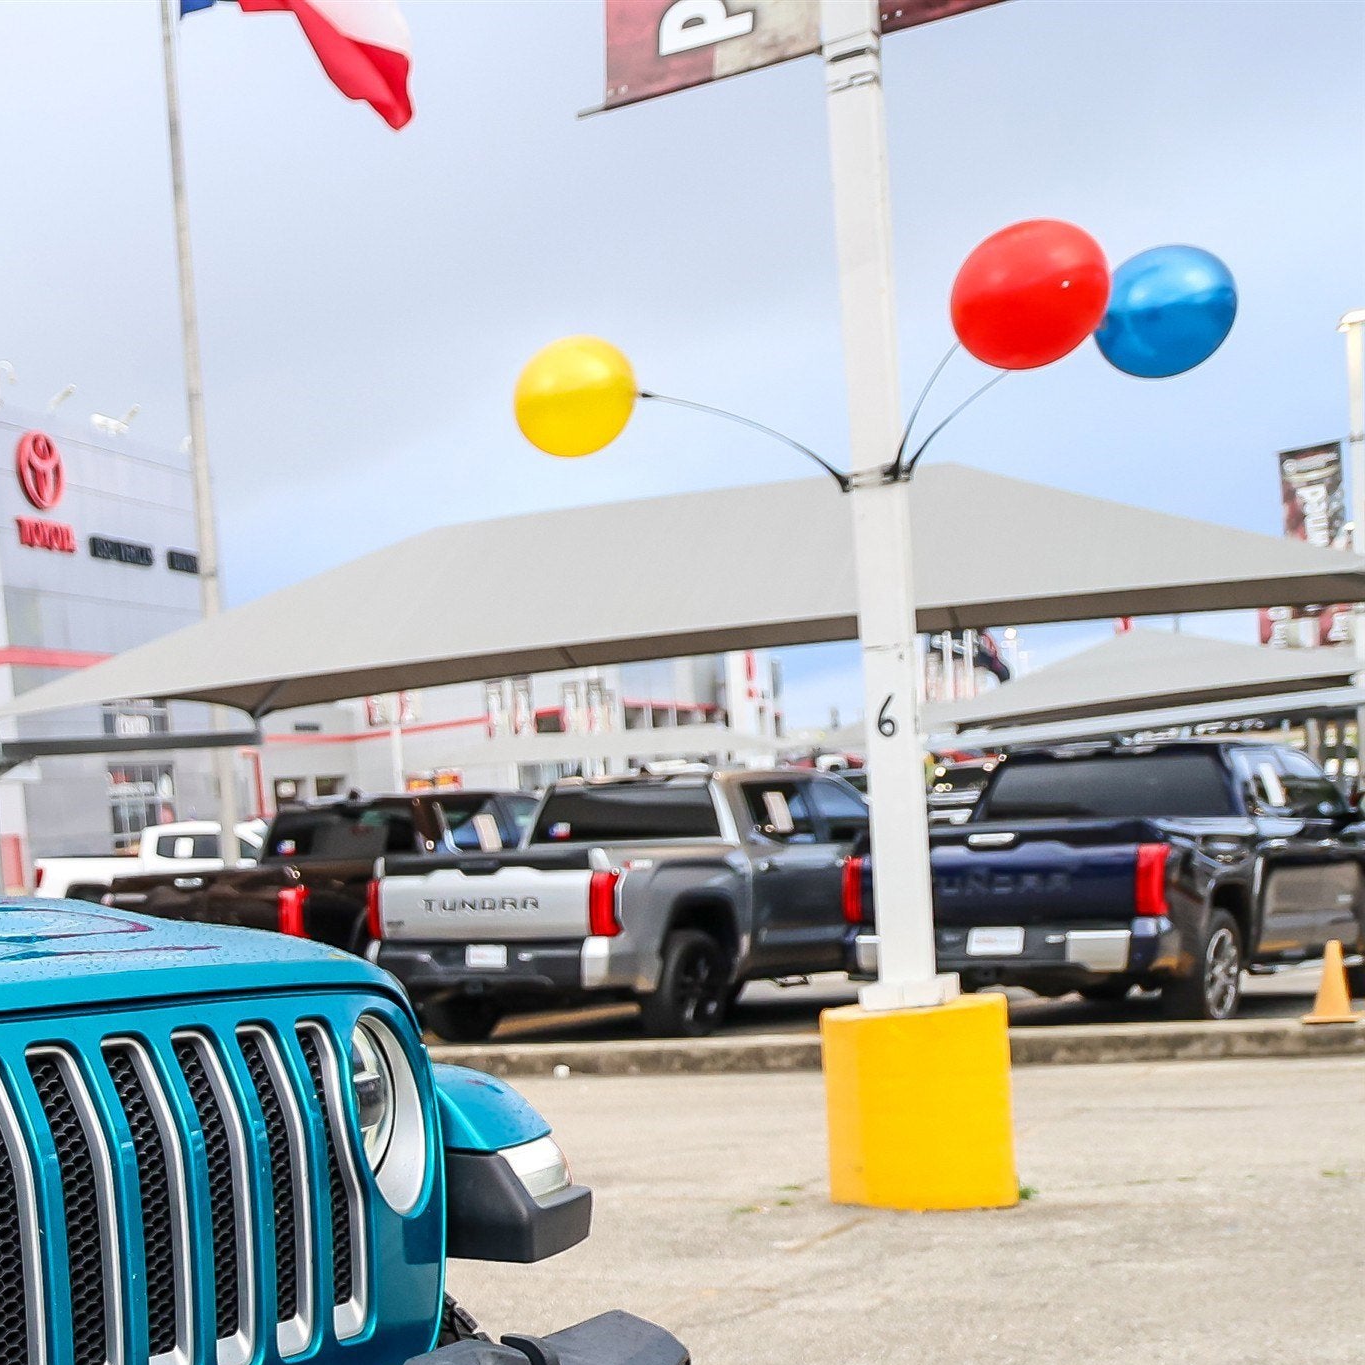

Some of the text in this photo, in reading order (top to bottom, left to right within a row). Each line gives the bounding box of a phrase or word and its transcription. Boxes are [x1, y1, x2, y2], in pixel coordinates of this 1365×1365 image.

[877, 694, 896, 737] 6
[938, 873, 1070, 897] UNDRA
[421, 896, 540, 915] TUNDRA
